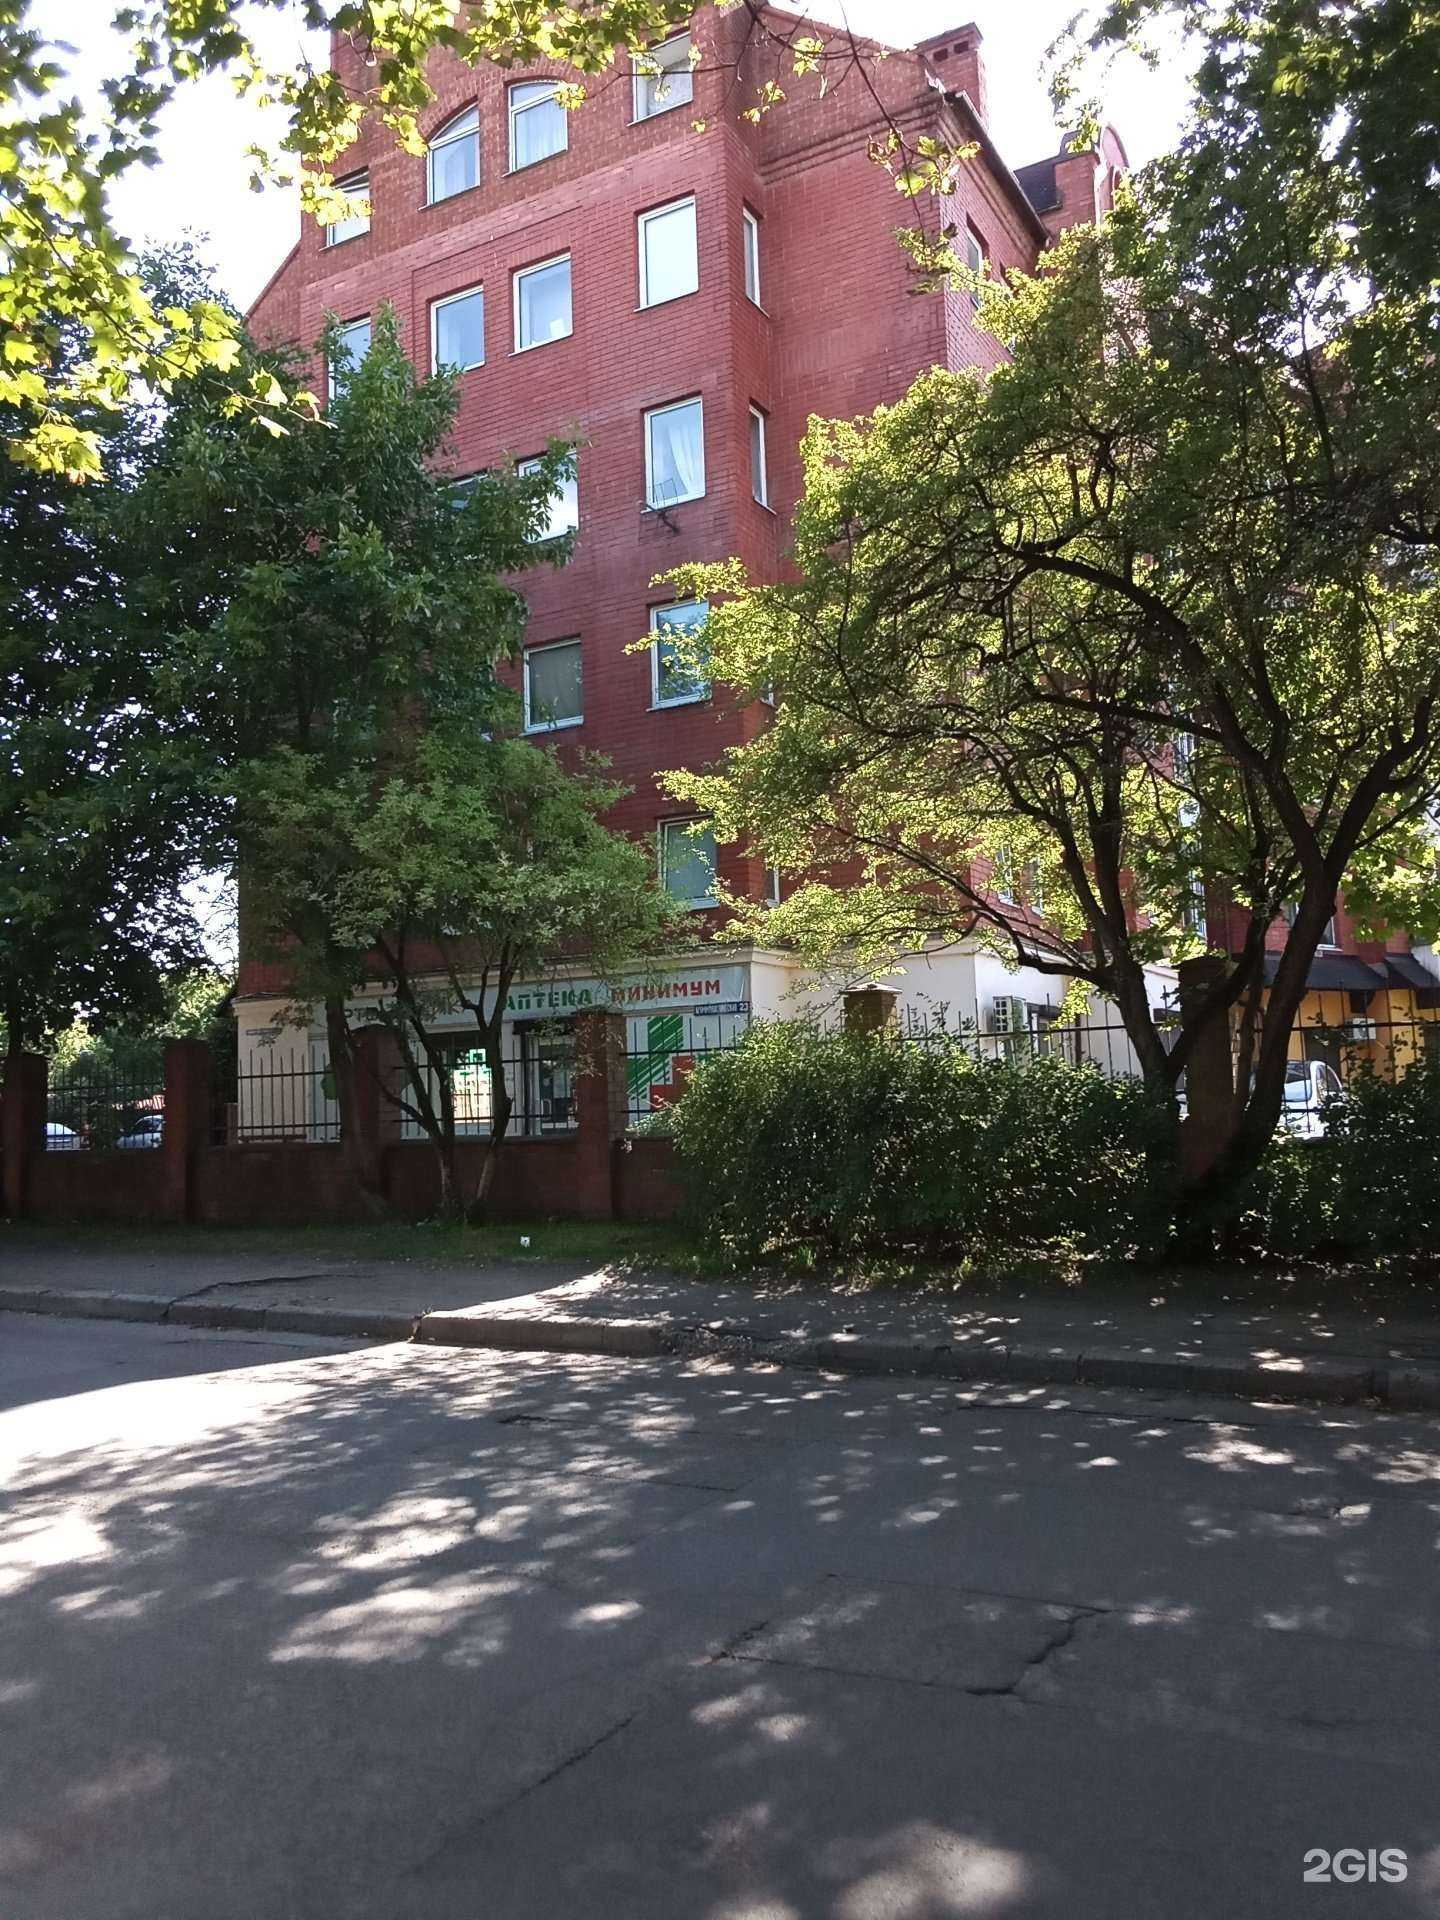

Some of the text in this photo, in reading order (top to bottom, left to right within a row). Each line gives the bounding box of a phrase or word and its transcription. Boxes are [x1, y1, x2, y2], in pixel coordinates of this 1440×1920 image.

[507, 979, 721, 1010] АПТЕКА МИНИМУМ
[739, 1002, 749, 1012] 23
